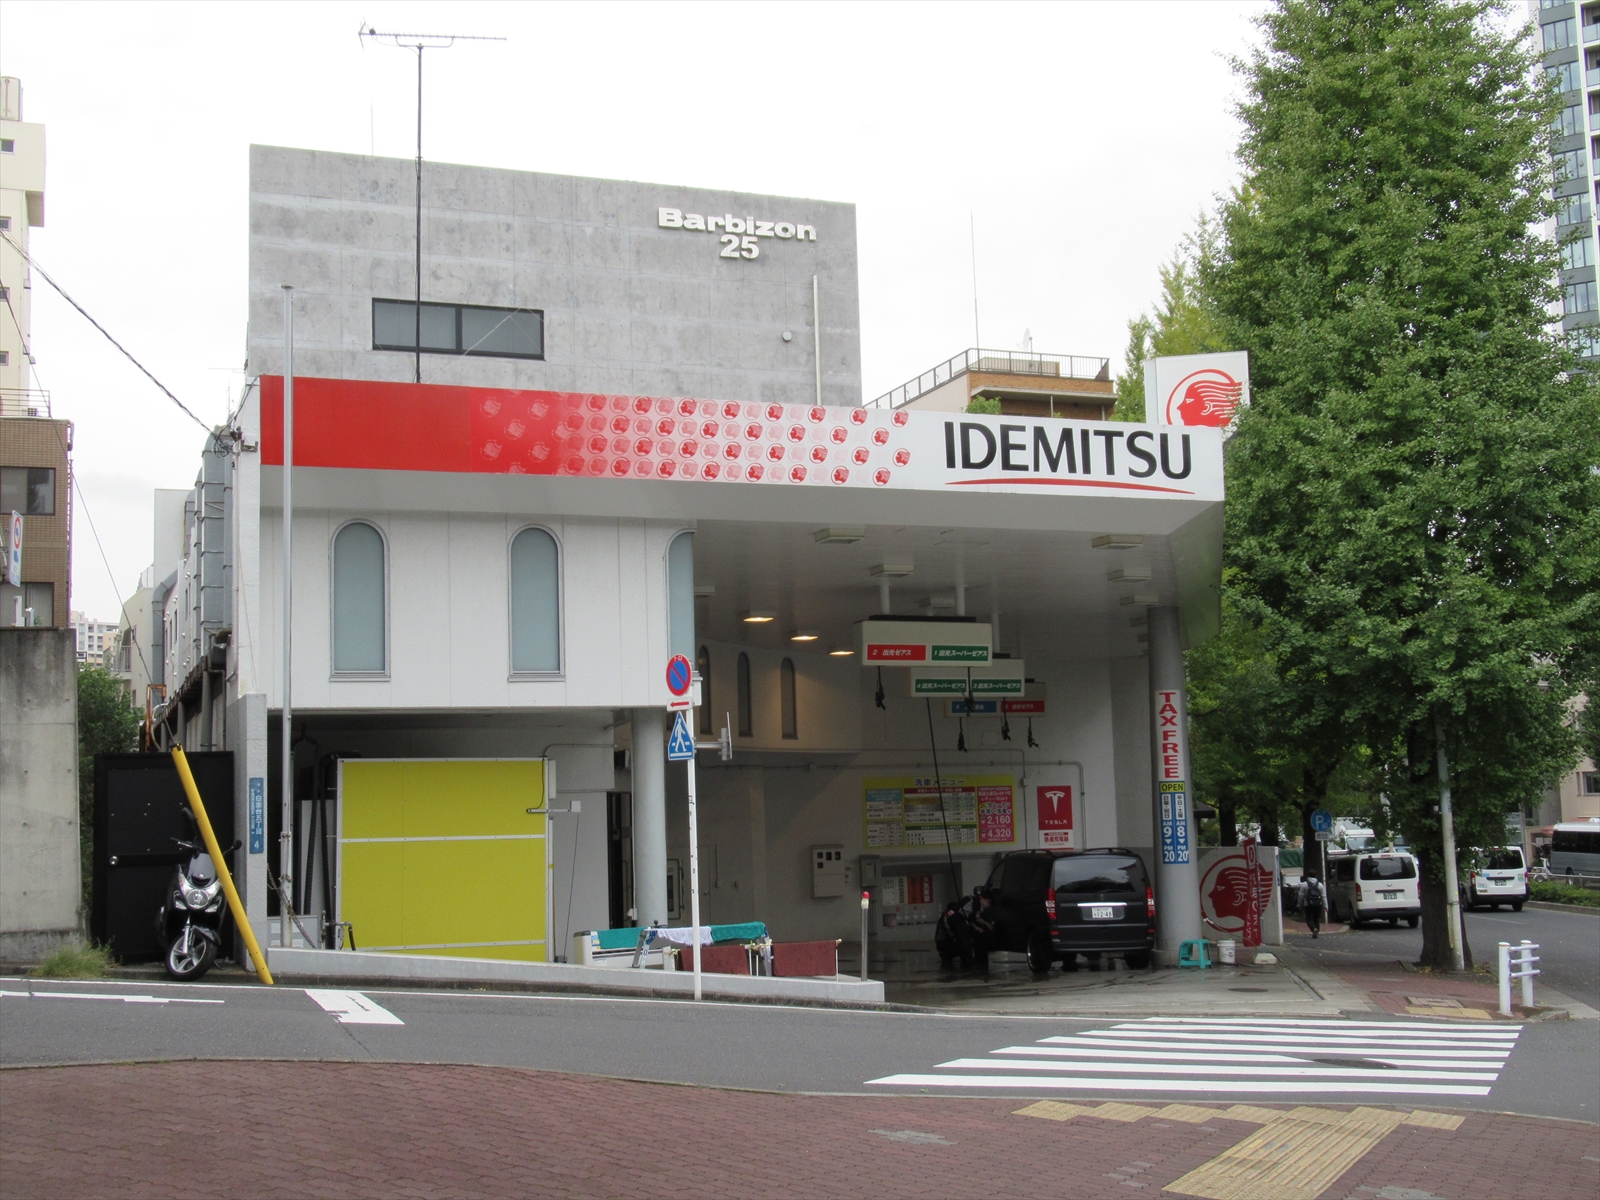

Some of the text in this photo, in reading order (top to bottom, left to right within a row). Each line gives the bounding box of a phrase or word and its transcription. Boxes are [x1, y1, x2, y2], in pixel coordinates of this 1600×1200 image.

[658, 207, 817, 241] Barbizon
[720, 234, 760, 259] 25
[944, 420, 1191, 480] IDEMITSU
[1158, 692, 1179, 779] TAX FREE
[914, 778, 965, 787] 洗車メニュー
[1161, 783, 1184, 792] OPEN
[1315, 815, 1324, 829] P
[1163, 826, 1173, 838] 9
[1176, 826, 1186, 838] 8
[1164, 851, 1175, 862] 20
